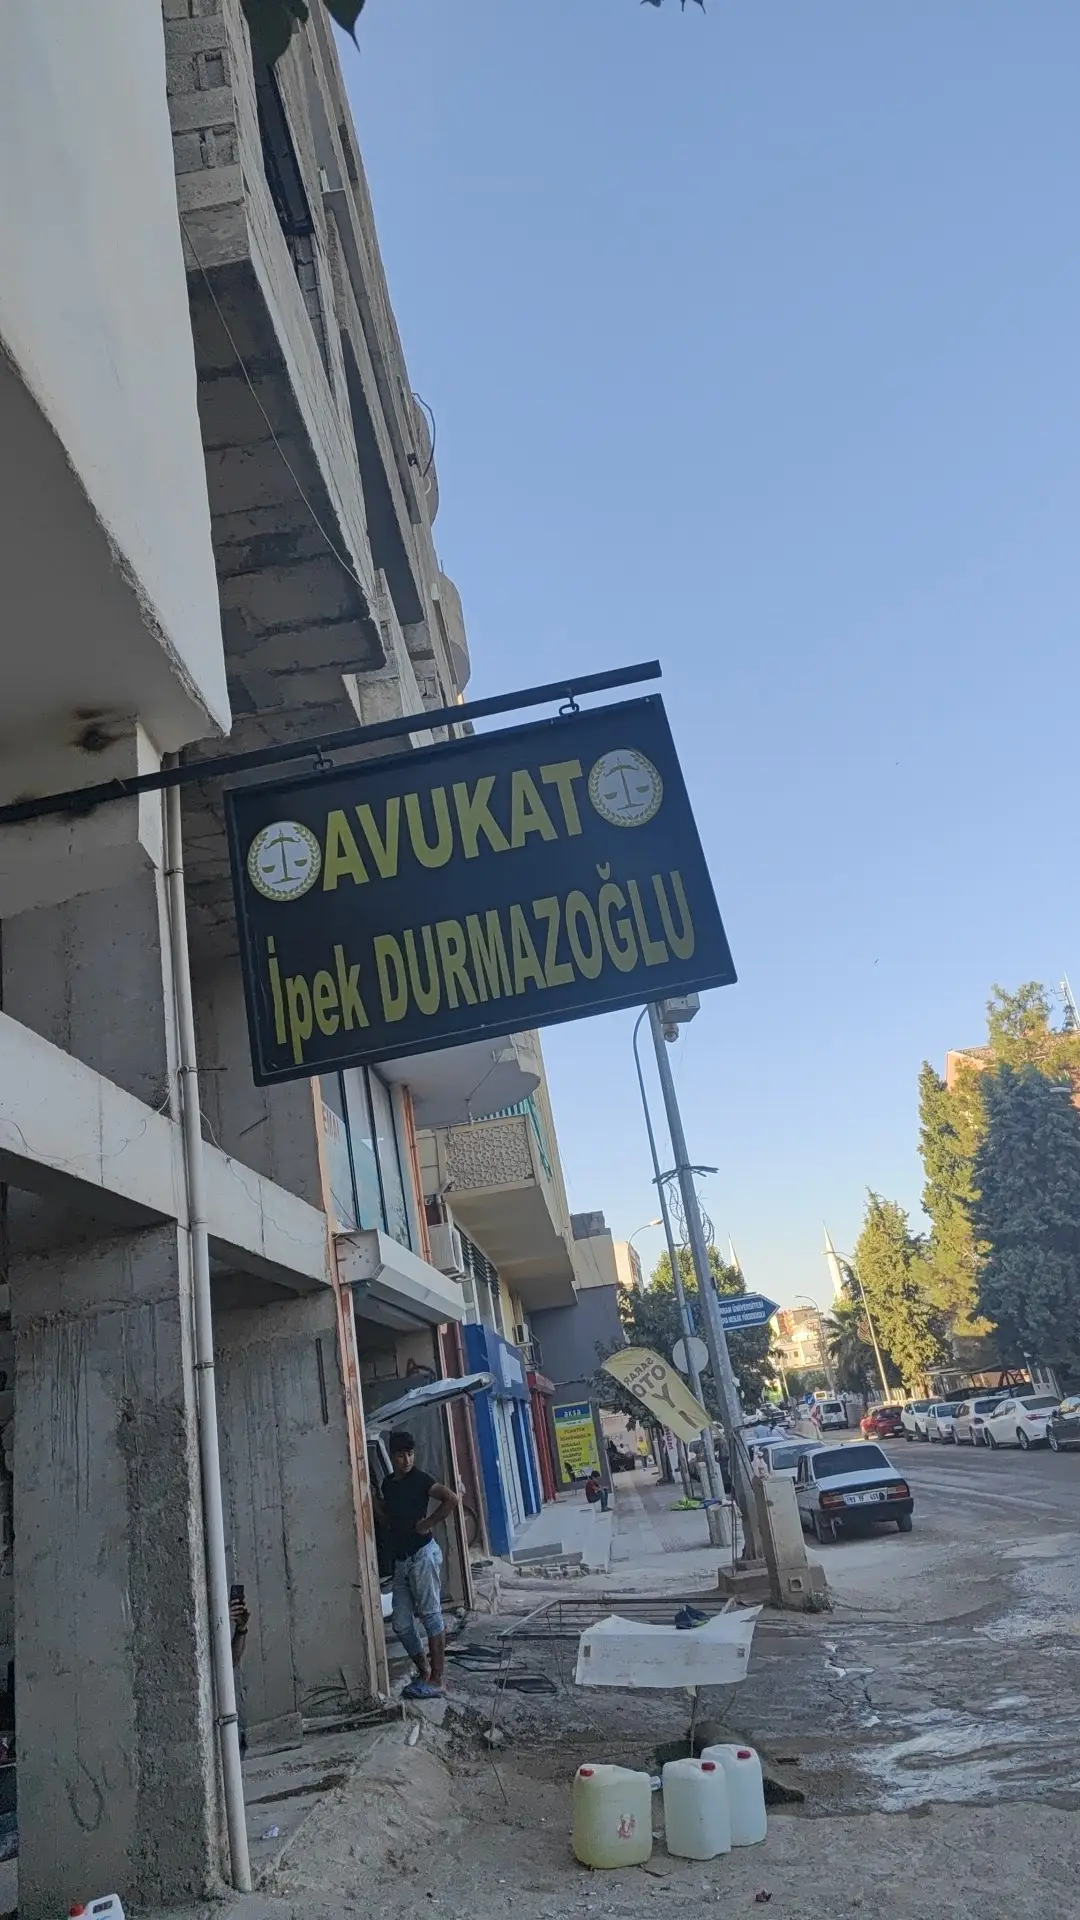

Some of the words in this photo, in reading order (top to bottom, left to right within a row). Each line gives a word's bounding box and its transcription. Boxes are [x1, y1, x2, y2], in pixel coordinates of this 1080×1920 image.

[323, 759, 583, 891] AVUKAT
[267, 936, 369, 1065] İpek
[373, 862, 696, 1023] DURMAZOĞLU
[564, 1409, 582, 1418] aksa
